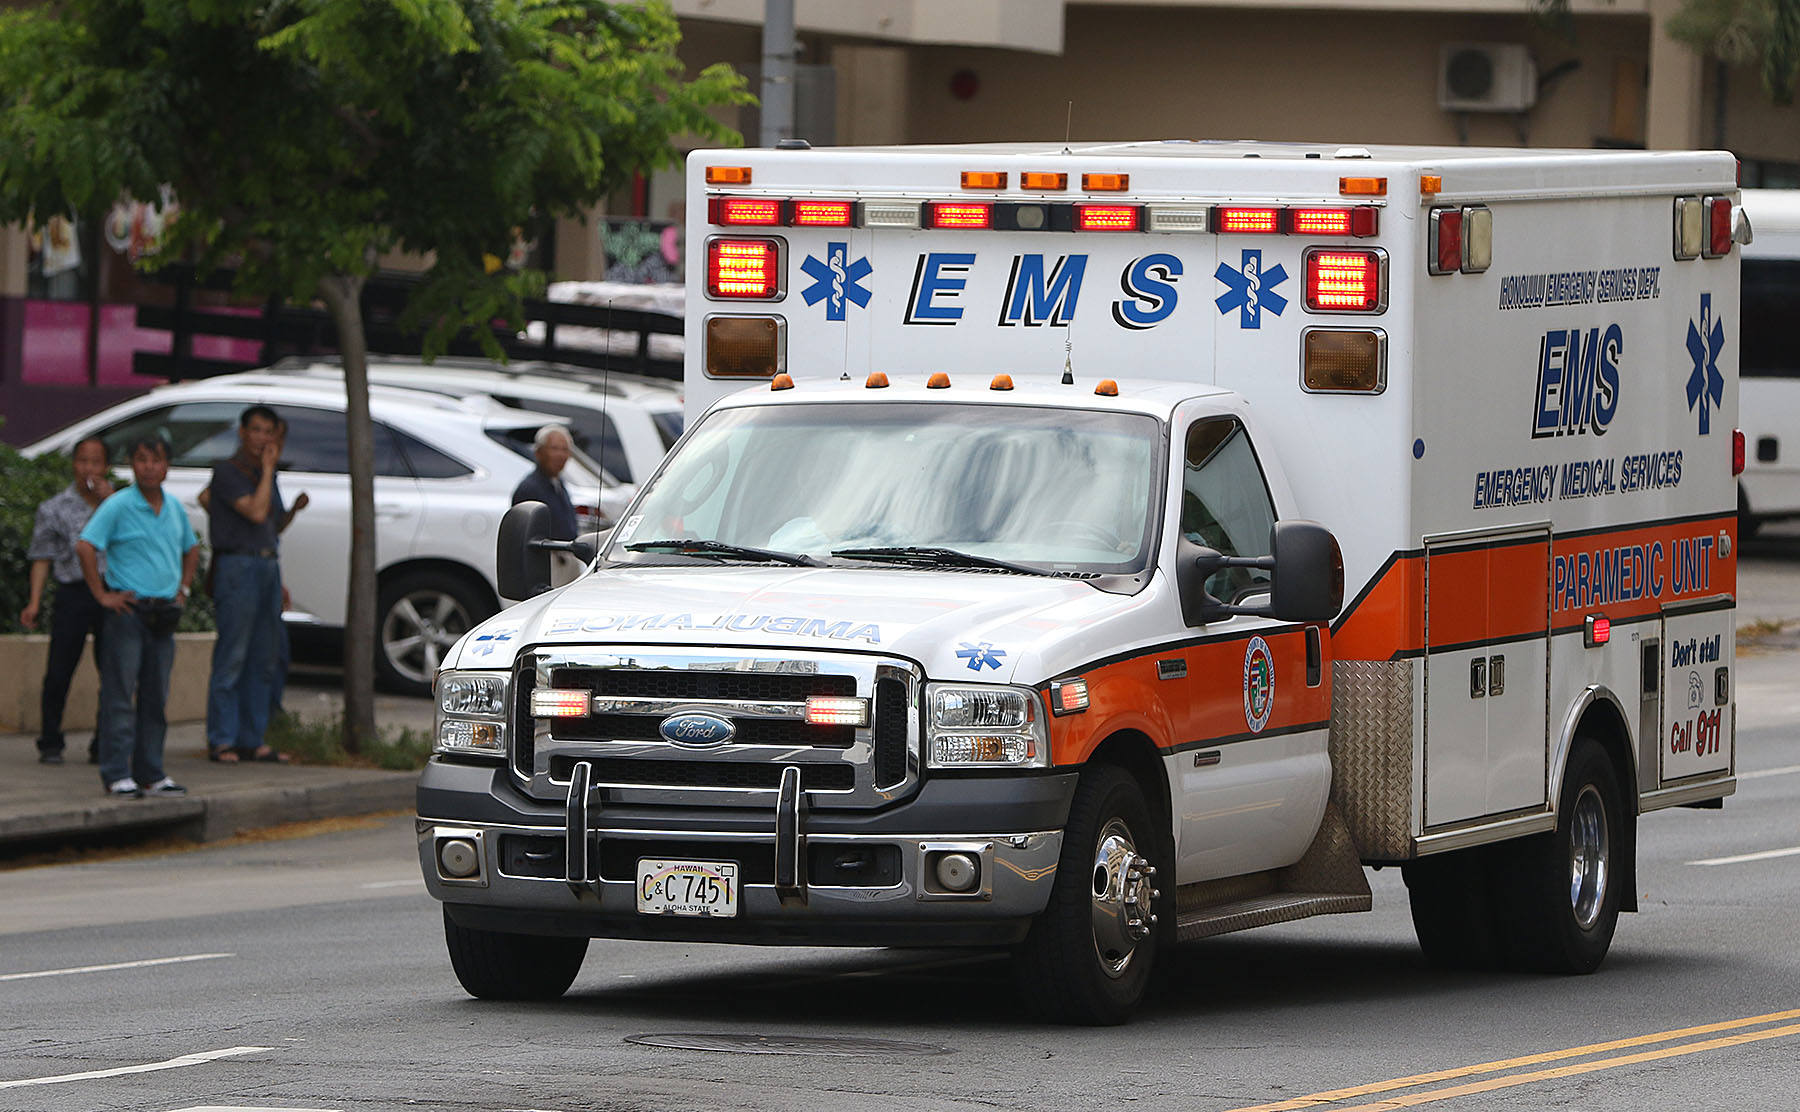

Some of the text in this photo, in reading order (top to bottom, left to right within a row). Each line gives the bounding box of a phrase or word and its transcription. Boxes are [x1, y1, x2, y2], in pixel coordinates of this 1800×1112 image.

[902, 252, 1184, 332] EMS
[1499, 266, 1660, 310] HONOLULU EMERGENCY SERVICES DEPT.
[1532, 323, 1623, 439] EMS
[1473, 450, 1683, 509] EMERGENCY MEDICAL SERVICES
[1554, 535, 1713, 612] PARAMEDIC UNIT
[1672, 634, 1720, 668] Don't stall
[675, 719, 716, 738] Ford
[1671, 708, 1722, 757] Call 911
[643, 874, 730, 904] C&C 7451
[663, 904, 711, 913] ALOHA STATE
